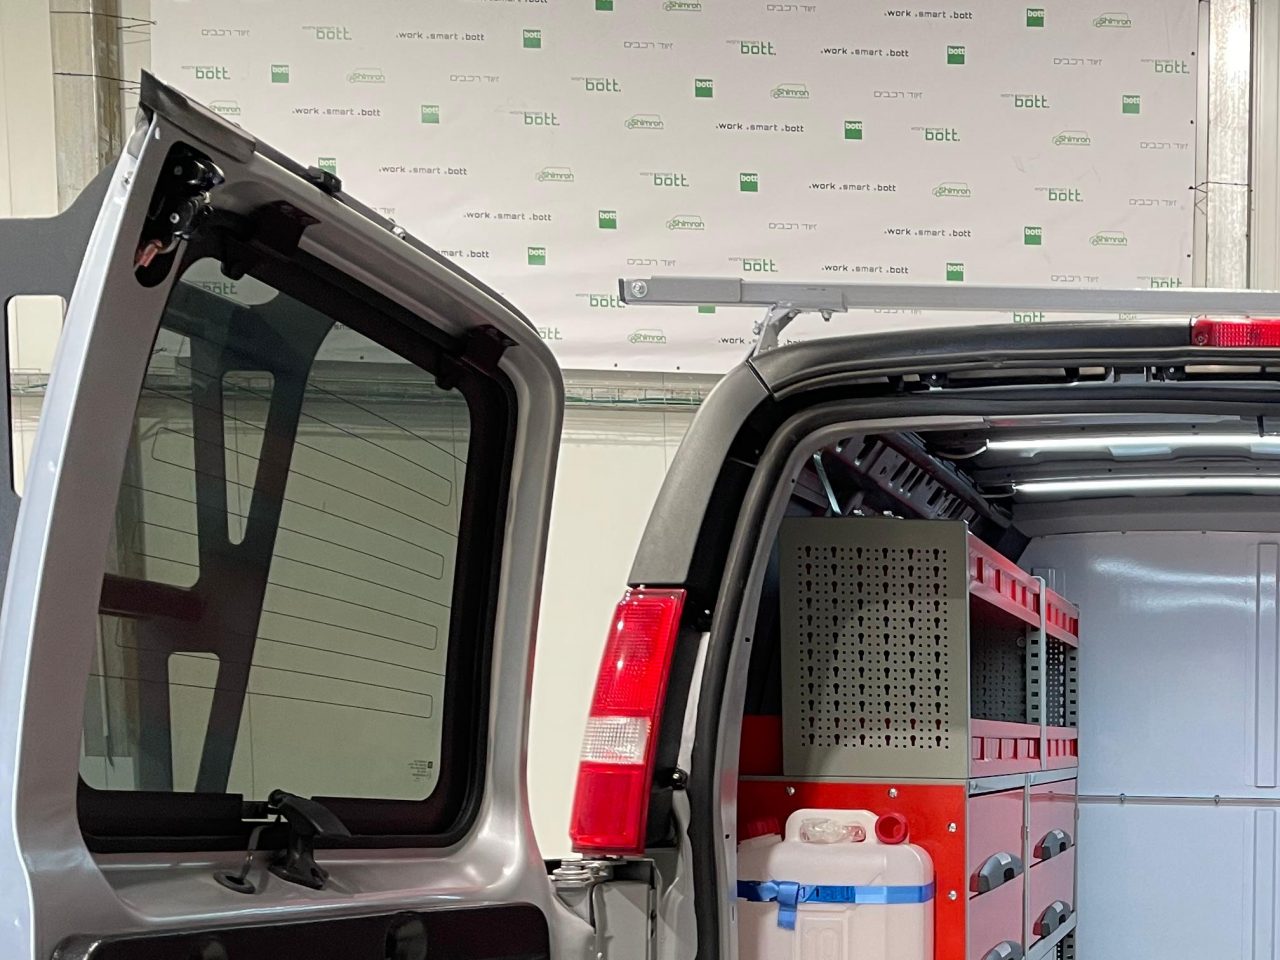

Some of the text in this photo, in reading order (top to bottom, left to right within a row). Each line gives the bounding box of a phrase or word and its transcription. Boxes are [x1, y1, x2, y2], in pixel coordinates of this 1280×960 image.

[671, 0, 702, 9] Shimron
[1101, 17, 1132, 25] Shimron
[354, 72, 385, 81] Shimron
[777, 88, 810, 97] Shimron
[632, 119, 664, 127] Shimron
[1059, 135, 1090, 143] Shimron
[543, 171, 574, 180] Shimron
[940, 186, 971, 195] Shimron
[673, 219, 705, 228] Shimron
[1096, 235, 1128, 244] Shimron
[636, 333, 666, 341] Shimron
